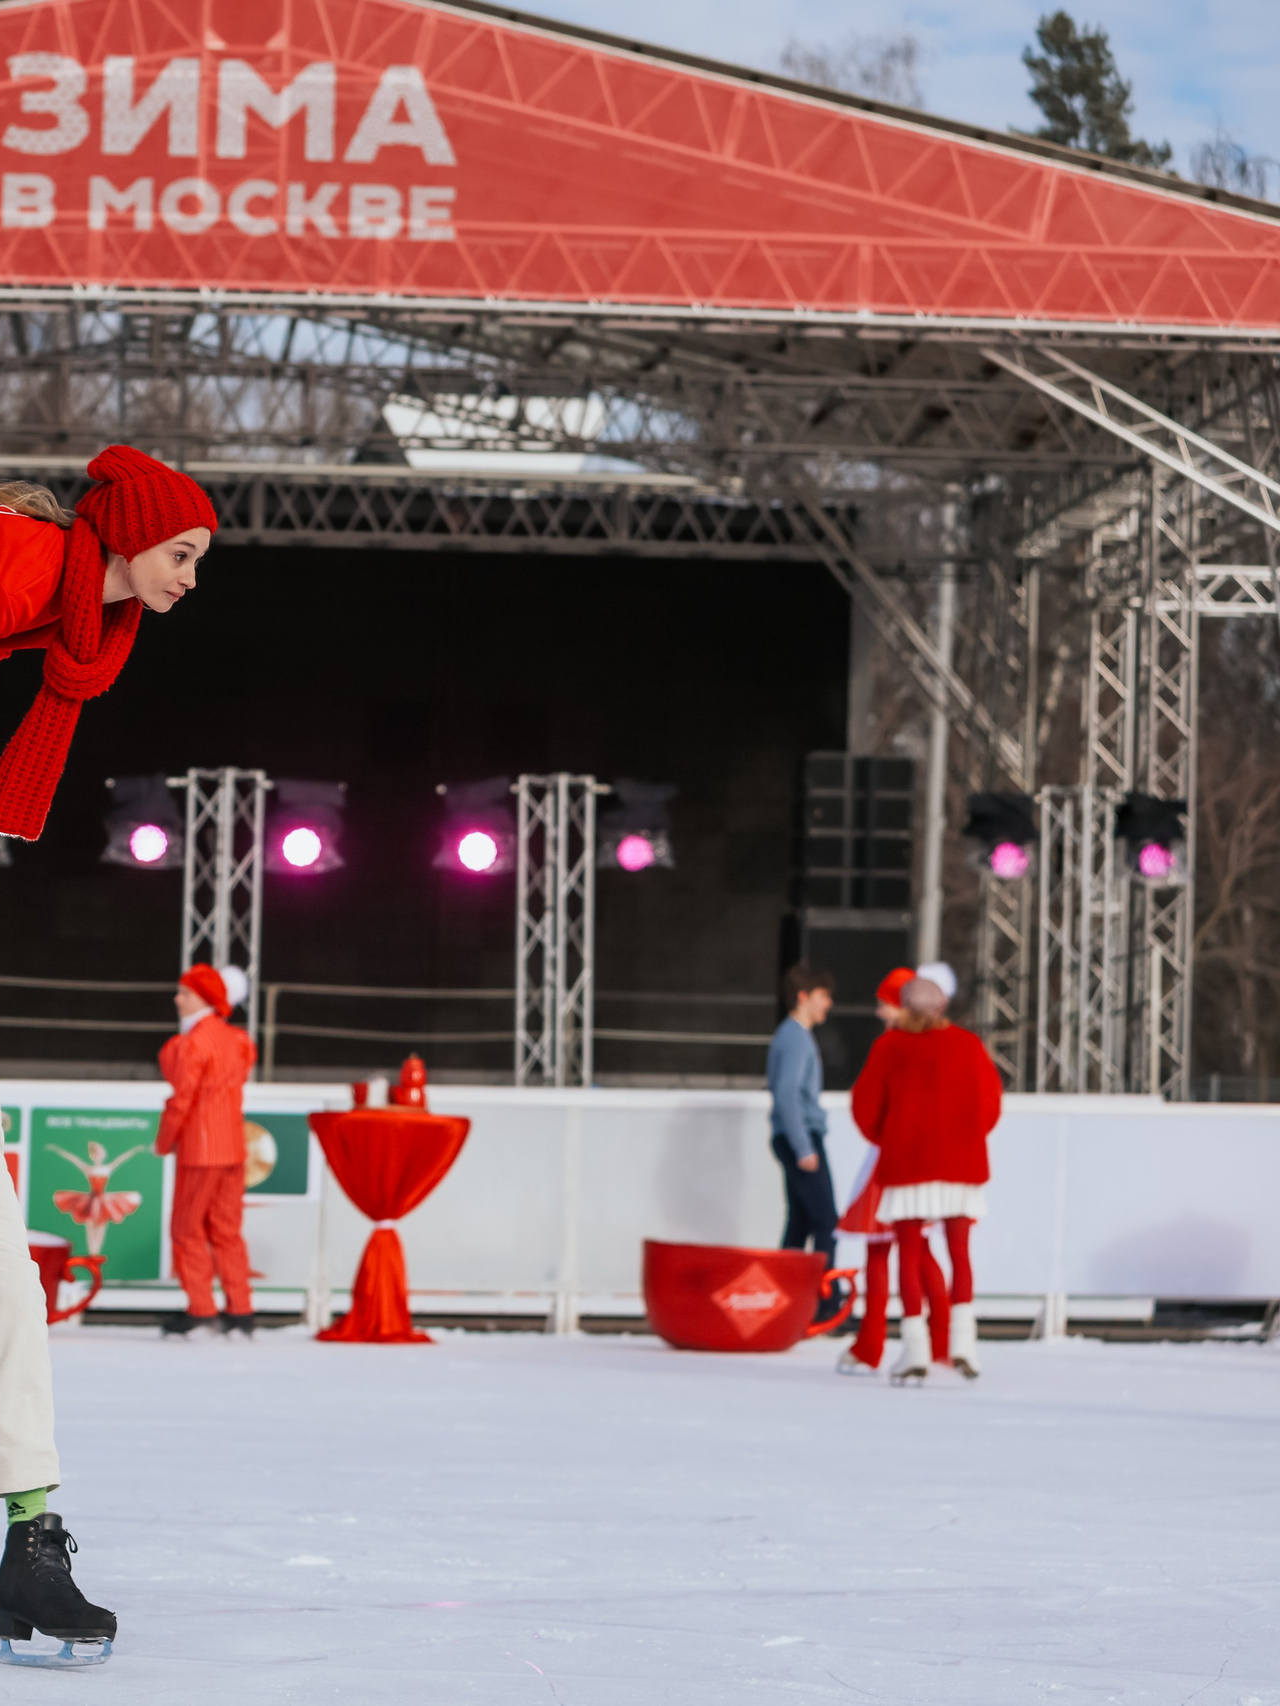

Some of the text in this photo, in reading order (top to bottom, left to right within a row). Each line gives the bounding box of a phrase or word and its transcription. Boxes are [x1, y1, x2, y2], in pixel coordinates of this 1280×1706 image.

[1, 51, 457, 167] ЗИМА
[1, 172, 457, 241] В МОСКВЕ
